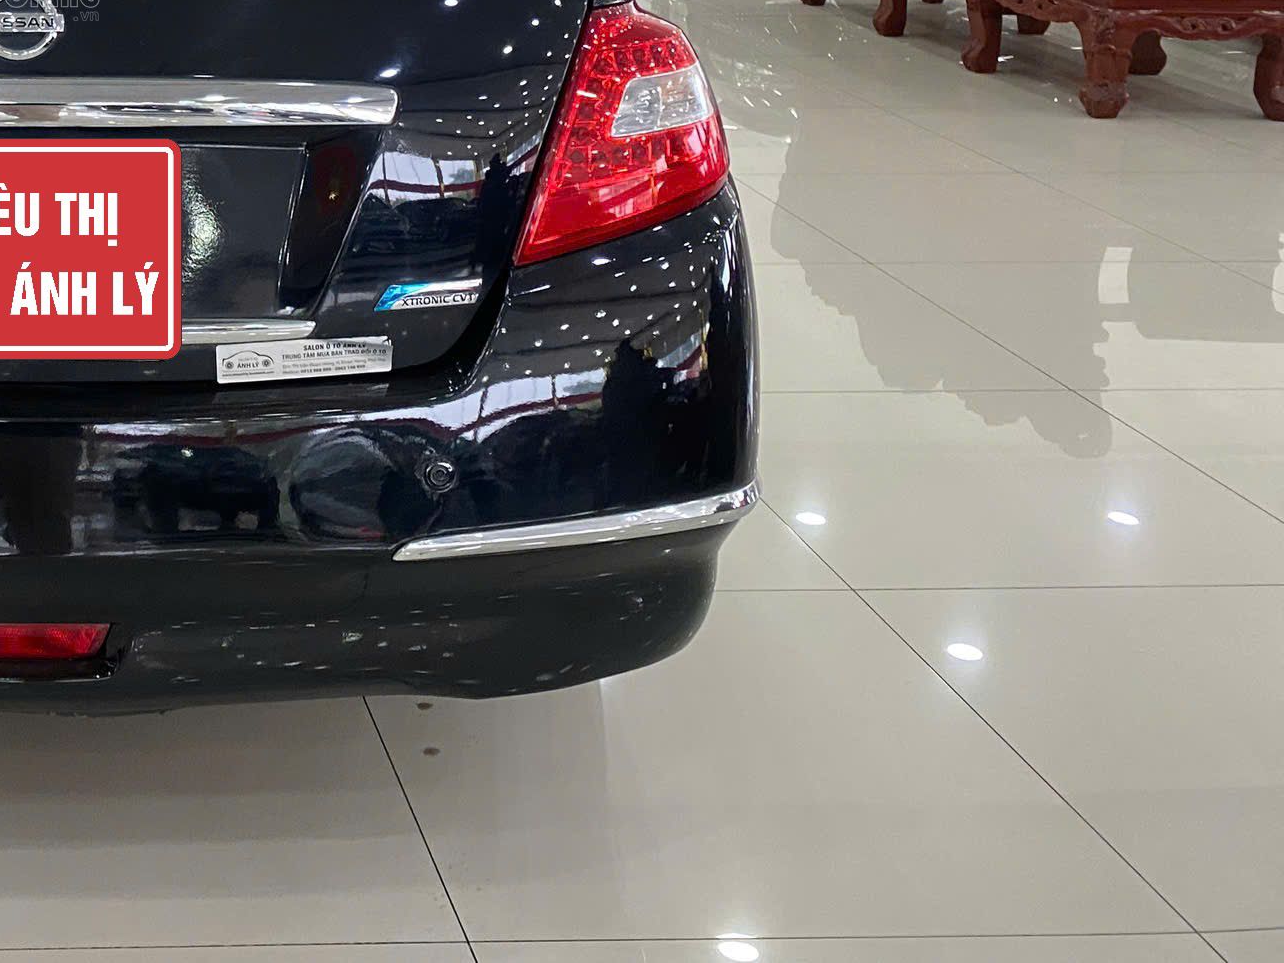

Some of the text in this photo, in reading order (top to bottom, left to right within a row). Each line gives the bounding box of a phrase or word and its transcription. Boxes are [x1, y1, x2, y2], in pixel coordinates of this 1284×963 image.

[401, 292, 476, 307] XTRONIC CVT
[303, 343, 324, 351] SALON
